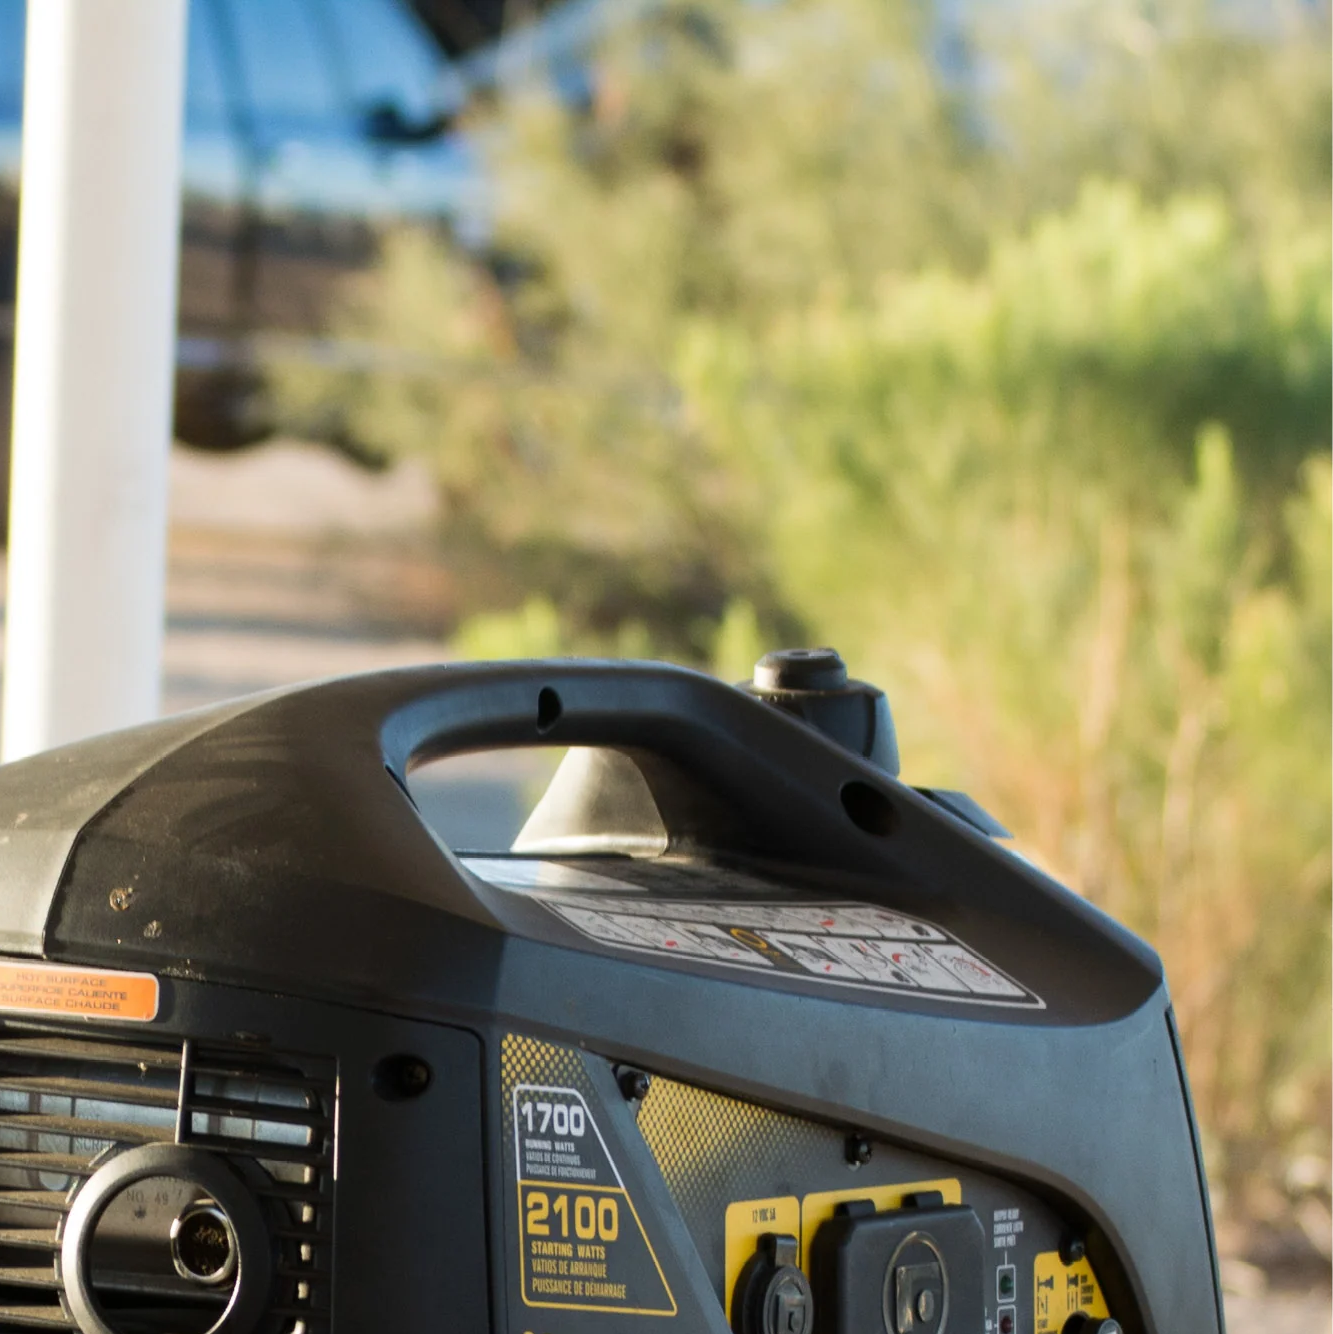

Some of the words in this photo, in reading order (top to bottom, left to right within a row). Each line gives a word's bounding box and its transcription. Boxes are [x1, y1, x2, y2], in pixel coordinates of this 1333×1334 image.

[47, 975, 107, 987] SURFACE
[1, 994, 61, 1006] SURFACE
[66, 998, 121, 1011] CHAUDE
[68, 988, 127, 1000] CALIENTE
[521, 1101, 585, 1137] 1700
[527, 1191, 619, 1241] 2100
[531, 1241, 573, 1257] STARTING
[577, 1244, 606, 1260] WATTS
[532, 1259, 556, 1275] VATIOS
[559, 1261, 568, 1275] DE
[532, 1277, 572, 1295] PUISSANCE
[574, 1281, 583, 1296] DE
